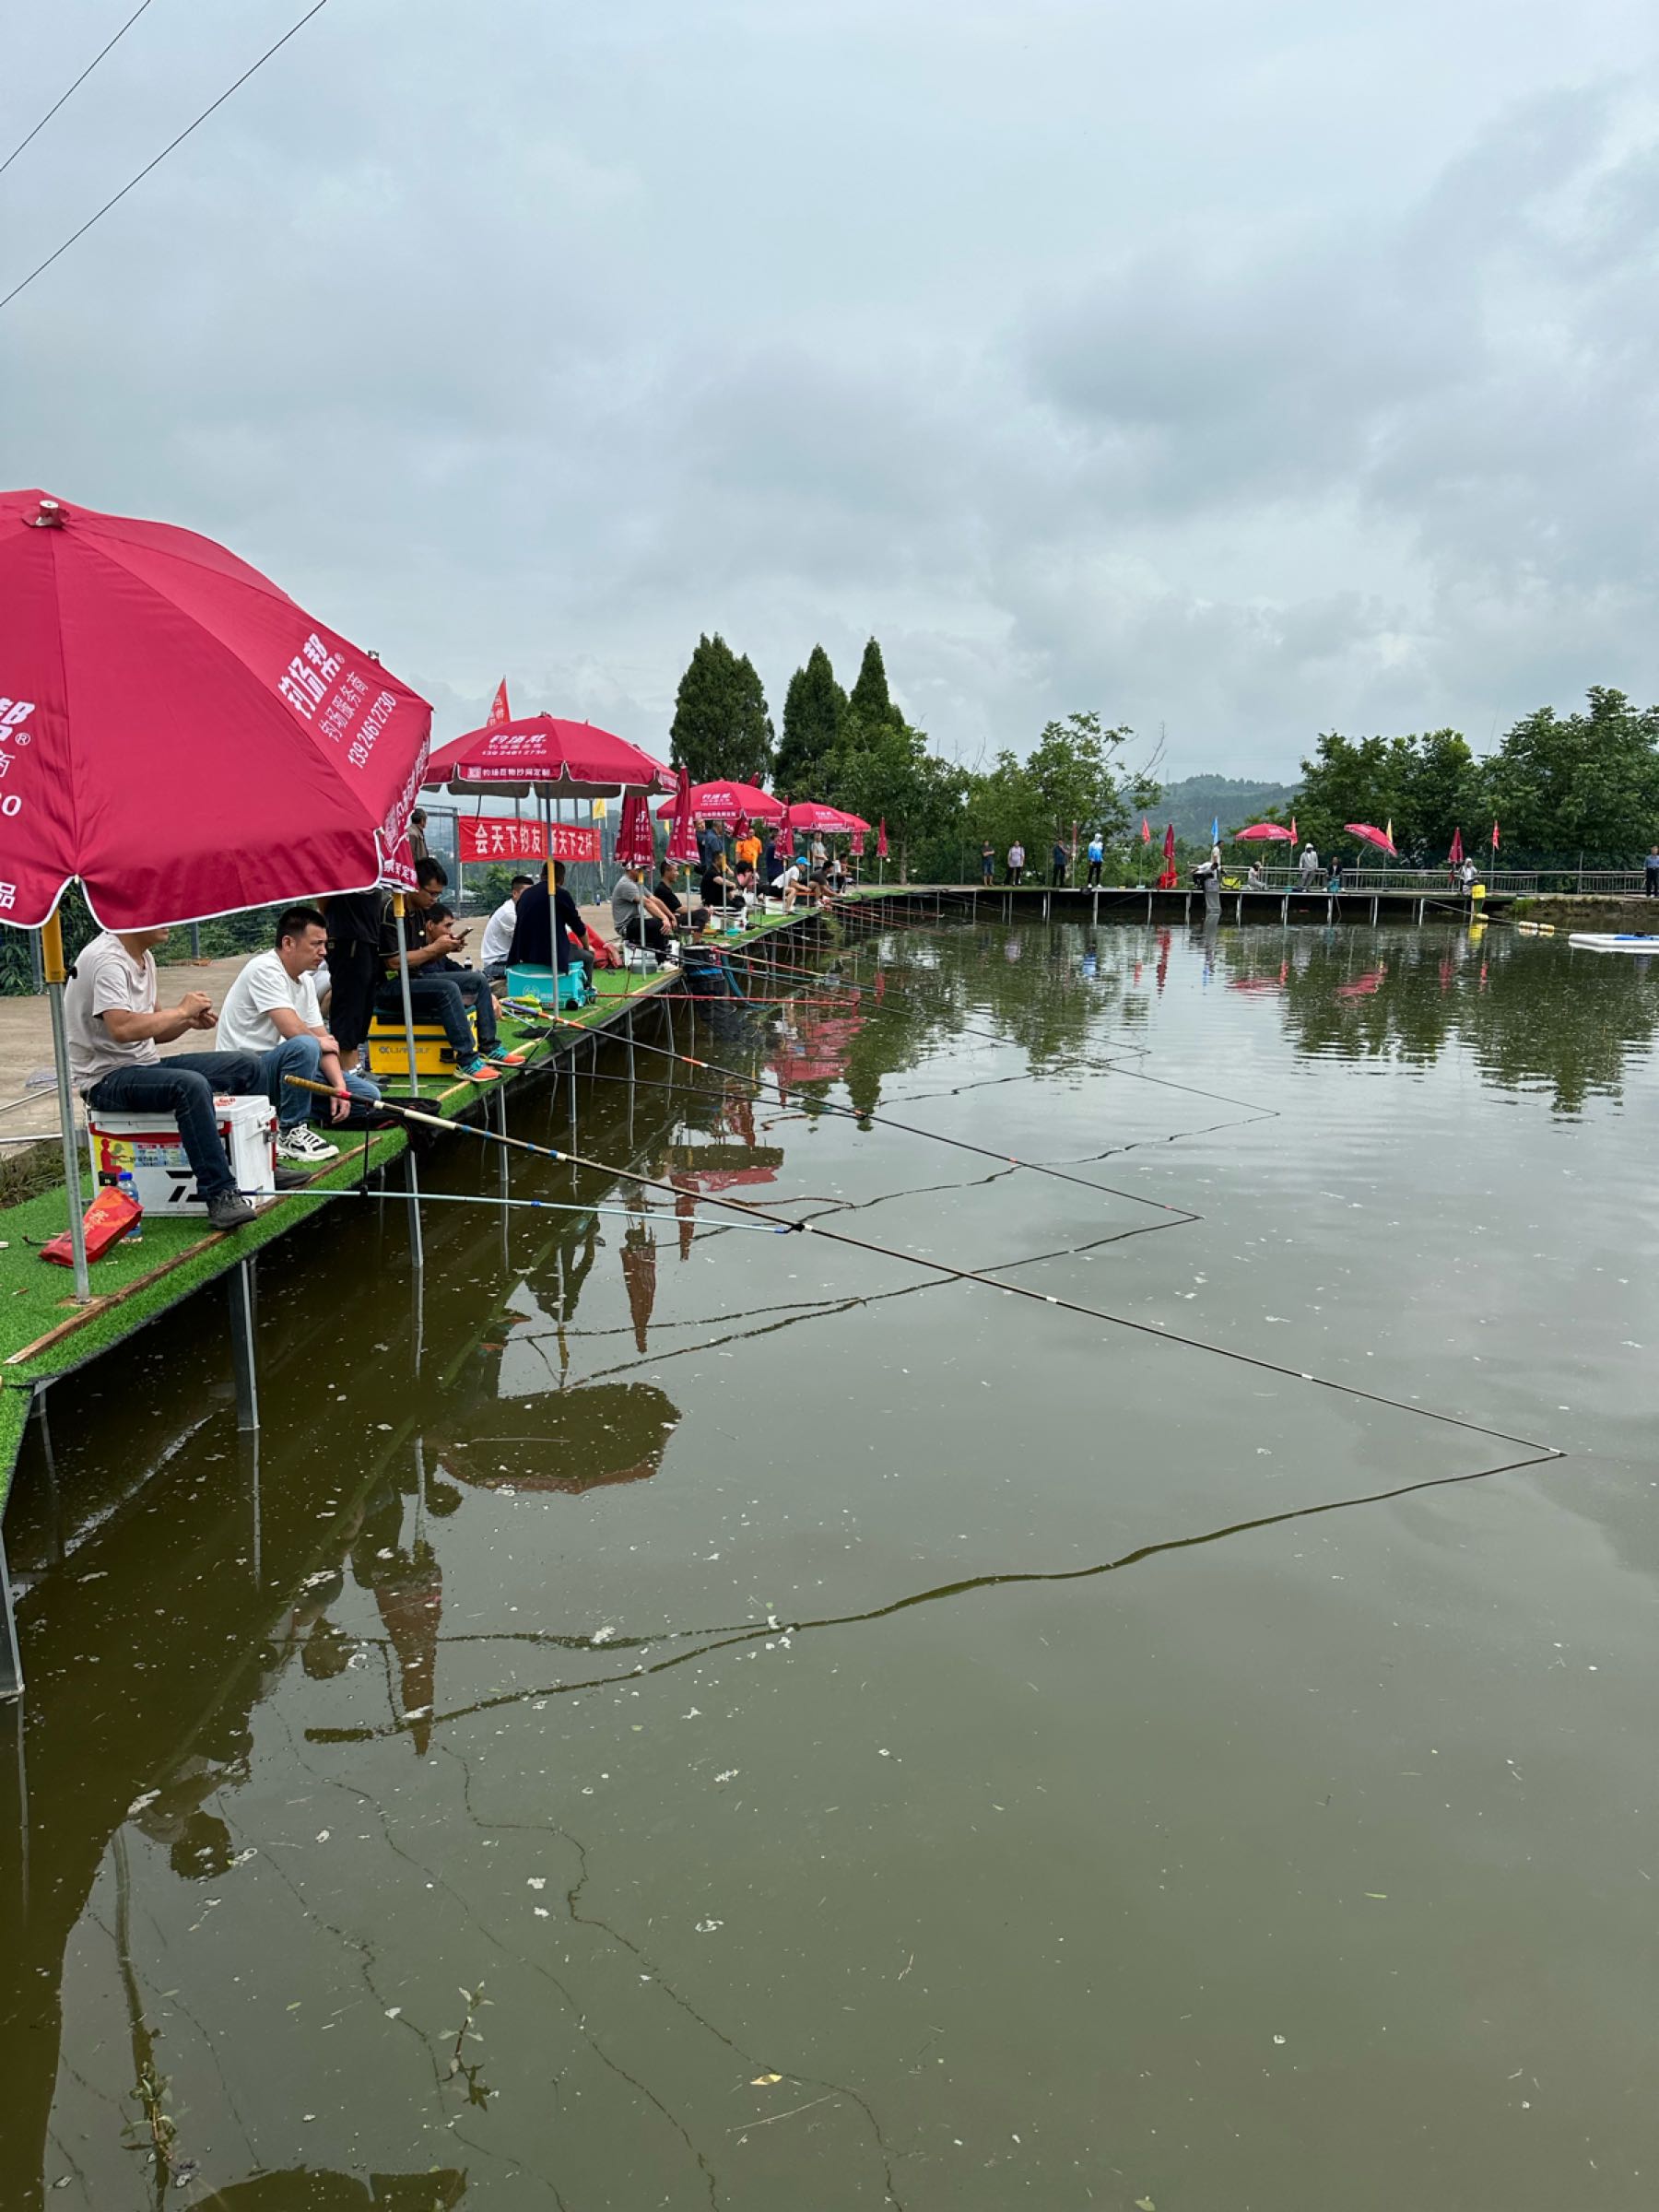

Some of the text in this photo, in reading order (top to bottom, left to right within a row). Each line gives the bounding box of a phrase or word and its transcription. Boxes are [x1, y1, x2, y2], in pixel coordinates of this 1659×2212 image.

[319, 672, 368, 743] 钓场服务商
[347, 691, 396, 769] 139 2461 2730
